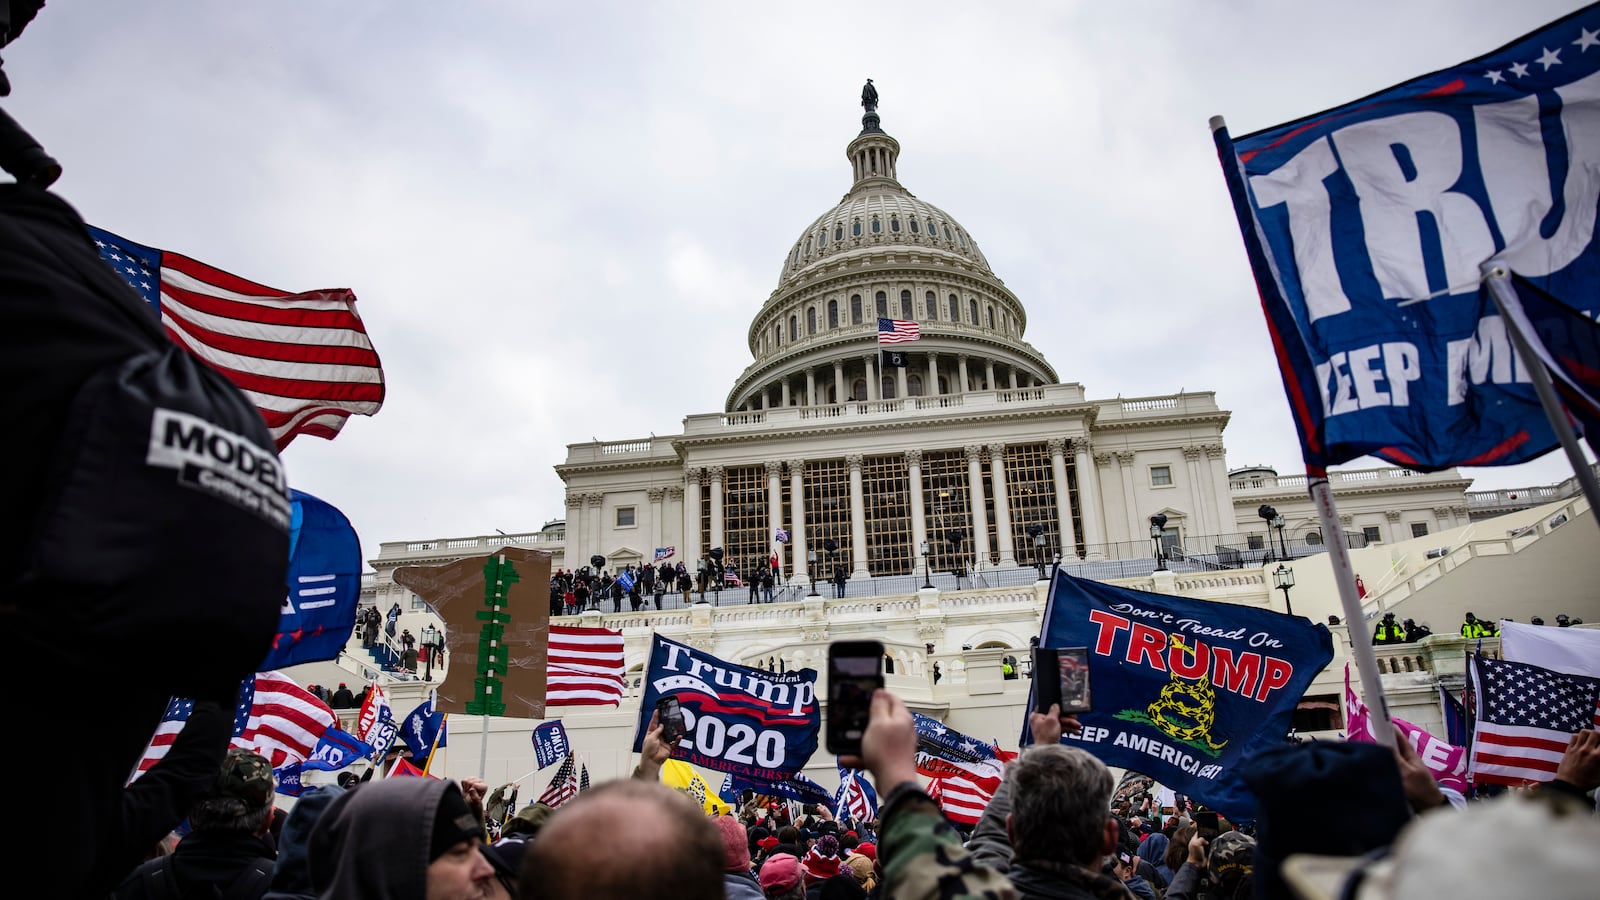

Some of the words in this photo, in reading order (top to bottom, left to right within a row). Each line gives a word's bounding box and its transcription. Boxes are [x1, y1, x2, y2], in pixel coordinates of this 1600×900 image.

[1108, 603, 1174, 624] Don't
[1176, 618, 1244, 640] Tread
[1249, 632, 1283, 648] On
[659, 640, 814, 716] Trump
[1089, 609, 1293, 702] TRUMP
[690, 753, 750, 776] AMERICA
[752, 767, 793, 781] FIRST
[1113, 731, 1200, 776] AMERICA
